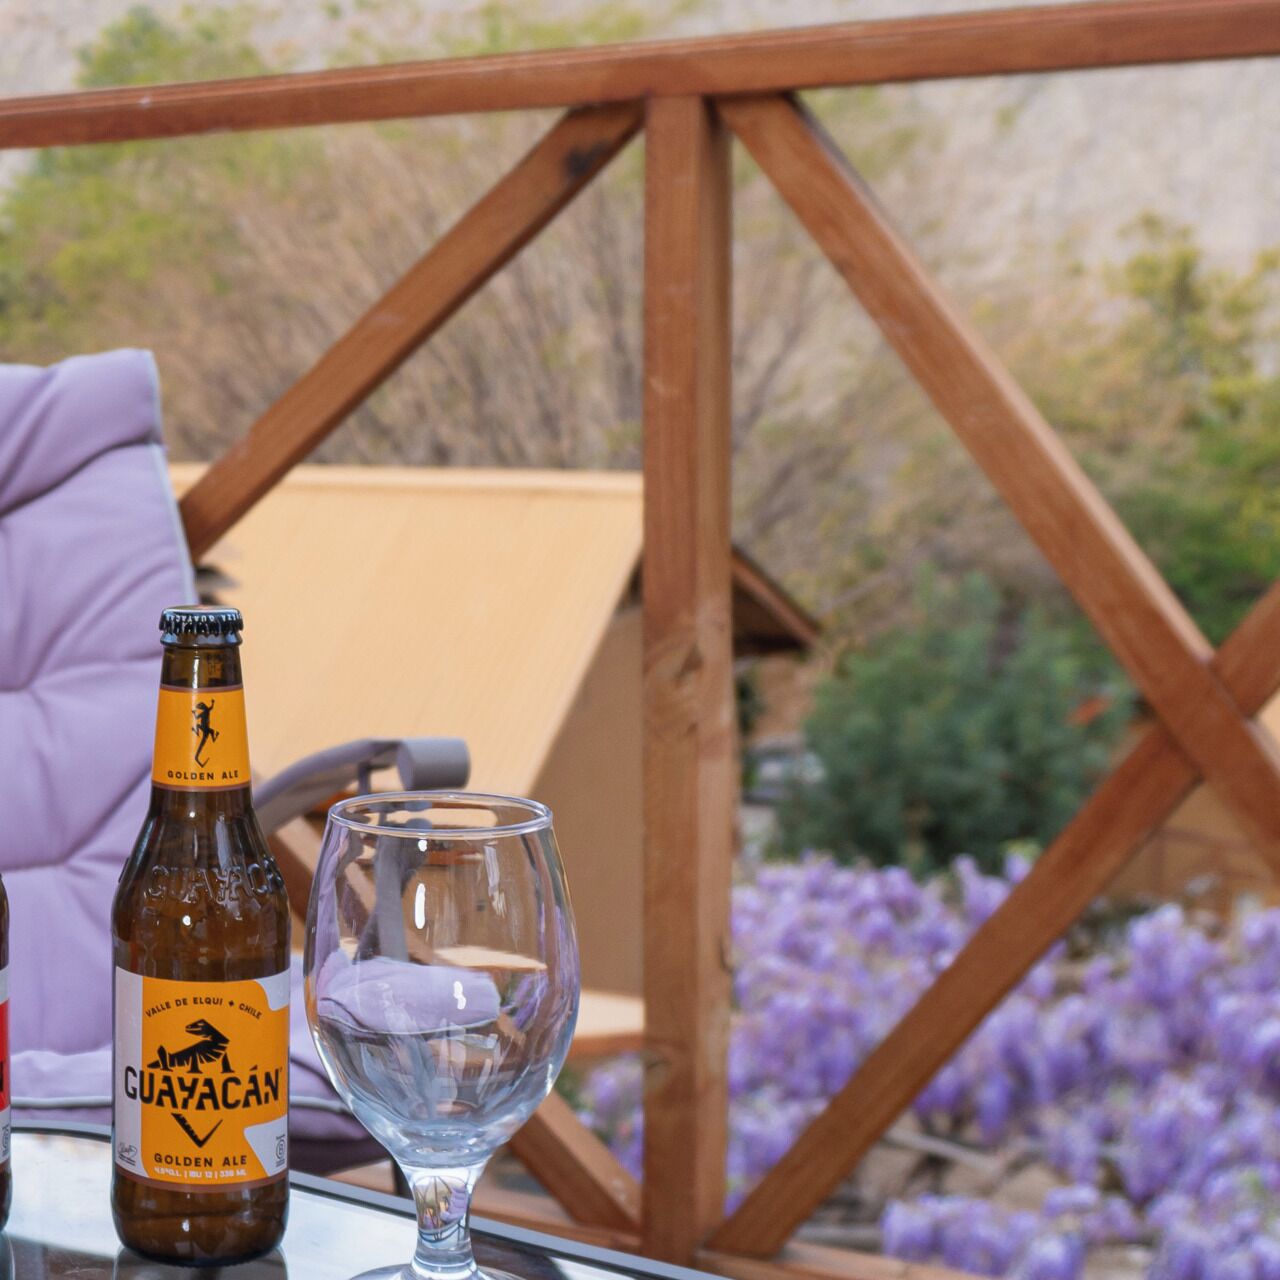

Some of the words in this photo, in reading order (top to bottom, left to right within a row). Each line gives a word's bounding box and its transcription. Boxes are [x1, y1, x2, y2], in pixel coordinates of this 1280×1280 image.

[167, 770, 215, 781] GOLDEN
[221, 770, 239, 779] ALE
[145, 1001, 172, 1019] VALLE
[175, 998, 188, 1007] DE
[193, 997, 224, 1007] ELQUI
[238, 1003, 263, 1020] CHILE
[124, 1064, 280, 1111] GUAYACÁN
[154, 1152, 213, 1167] GOLDEN
[222, 1155, 247, 1167] ALE
